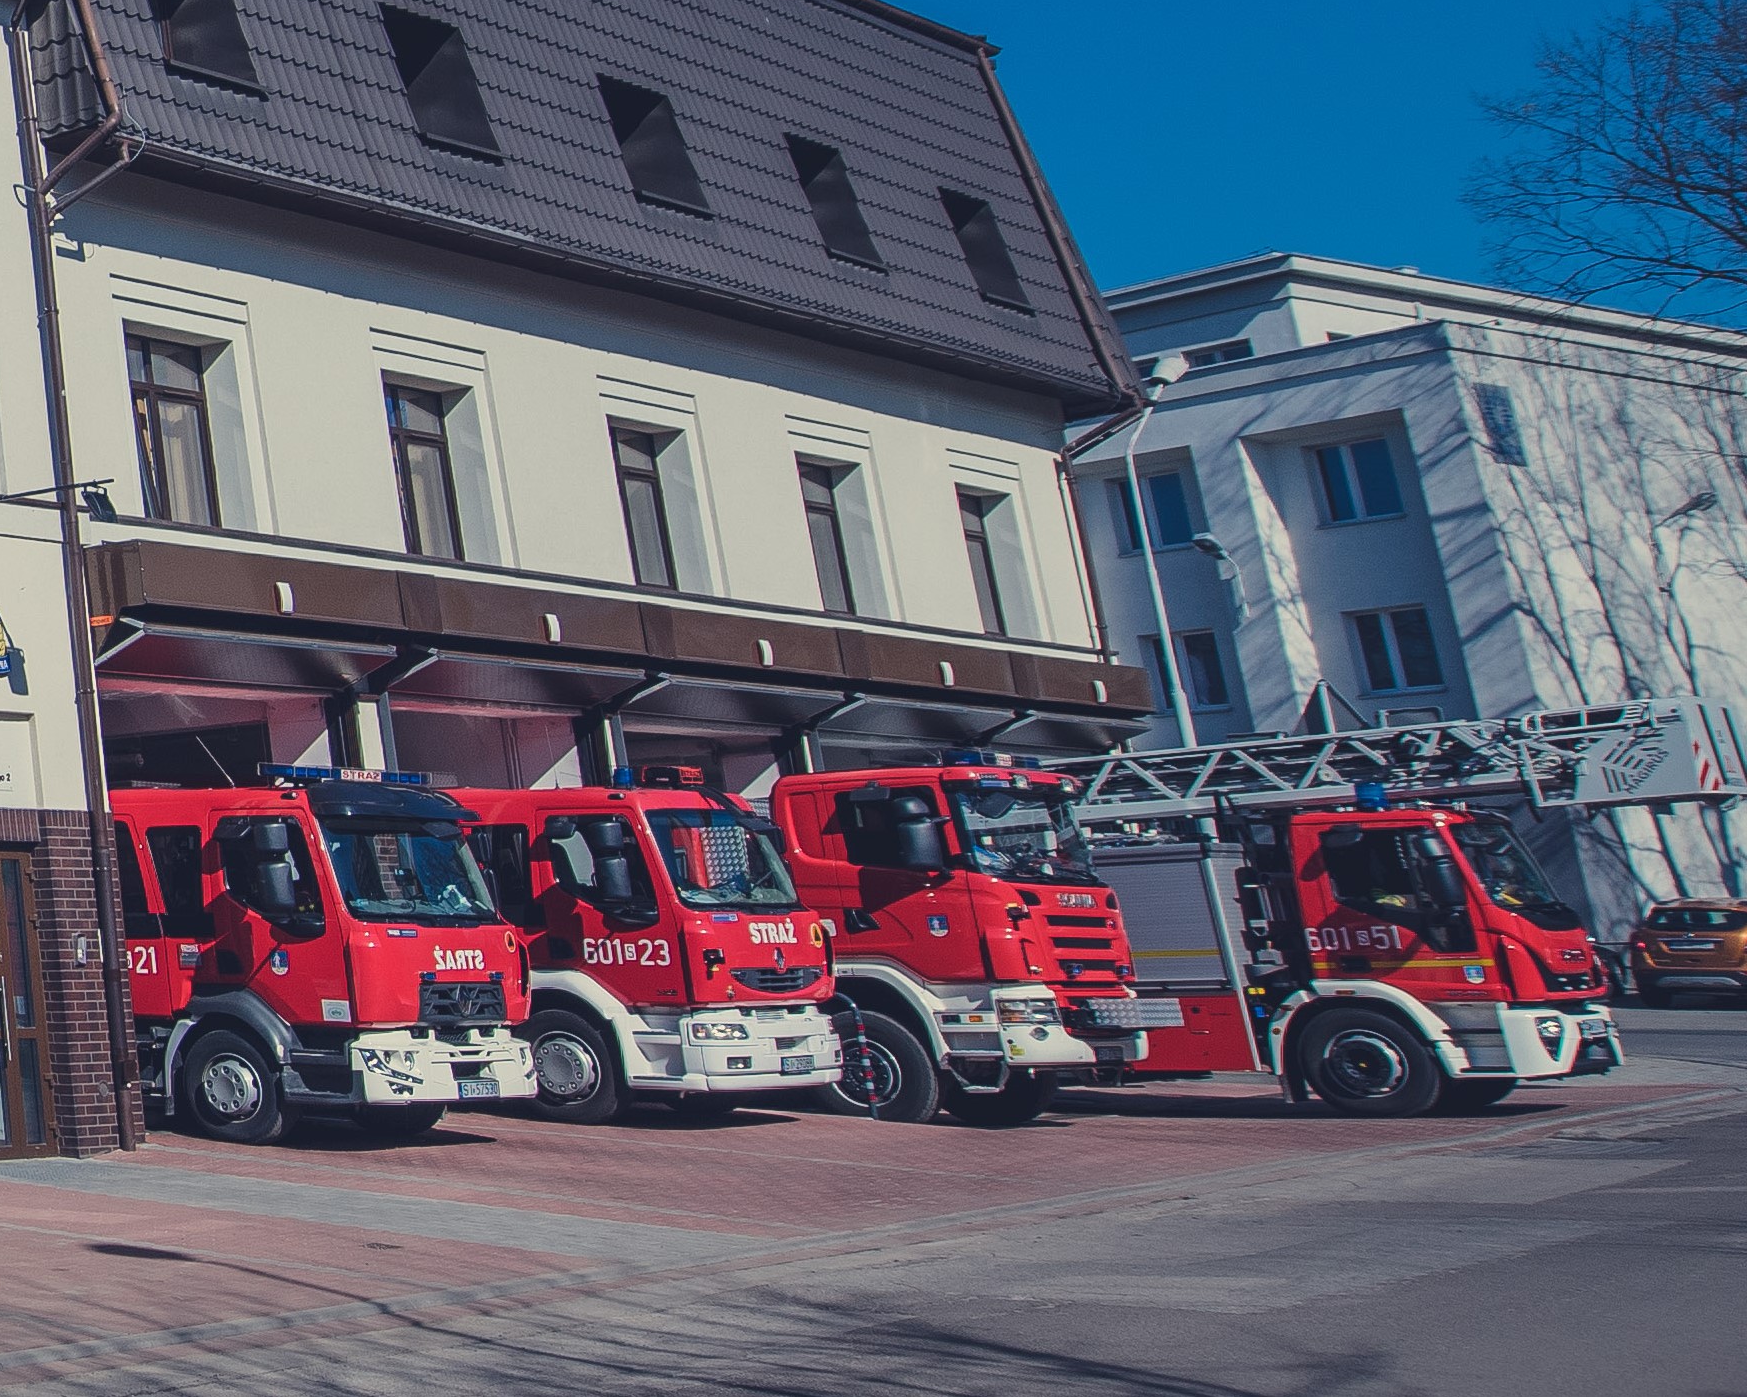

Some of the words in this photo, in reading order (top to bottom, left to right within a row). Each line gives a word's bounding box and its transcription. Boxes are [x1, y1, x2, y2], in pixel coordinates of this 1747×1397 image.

[749, 918, 798, 944] STRAŻ
[1304, 926, 1351, 951] 601
[1370, 924, 1402, 950] 51
[134, 946, 157, 974] 21
[583, 937, 624, 964] 601
[625, 944, 636, 960] S
[637, 938, 671, 966] 23
